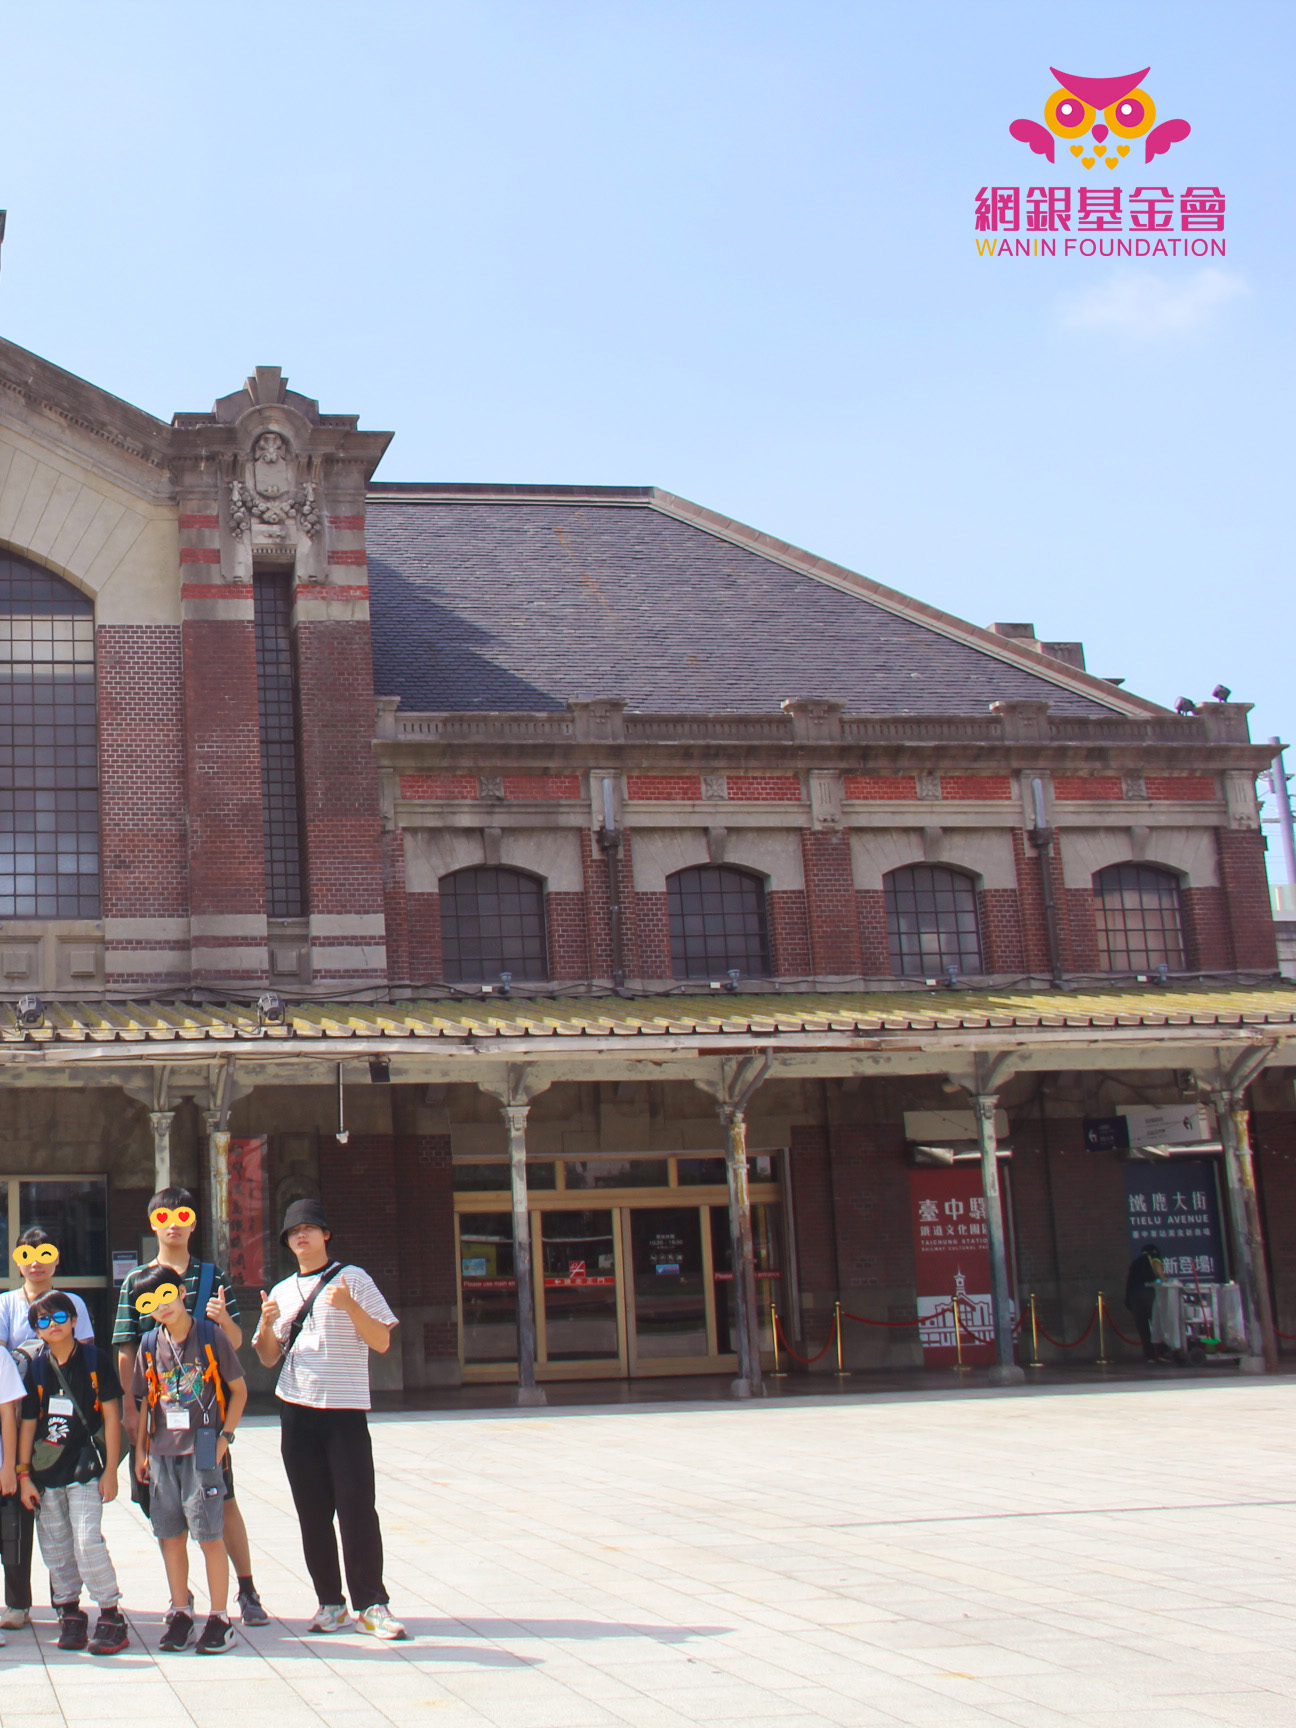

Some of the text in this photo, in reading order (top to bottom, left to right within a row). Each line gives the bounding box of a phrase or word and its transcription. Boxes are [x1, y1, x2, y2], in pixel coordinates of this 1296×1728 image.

[1128, 1191, 1207, 1212] 鐵鹿大街
[1129, 1214, 1209, 1225] TIELU AVENUE
